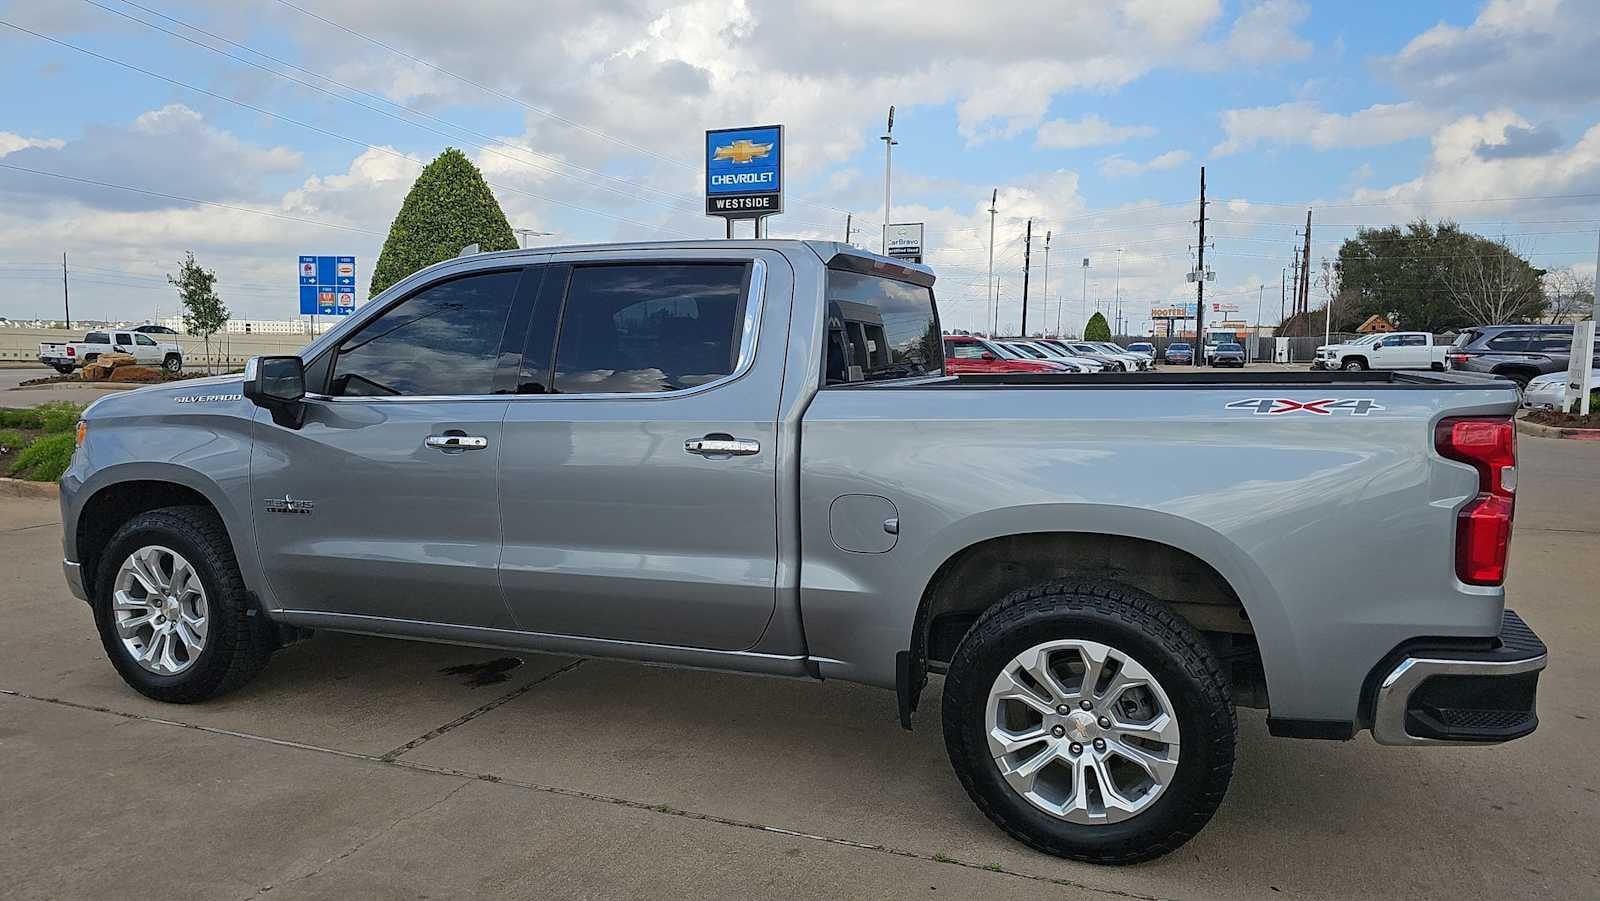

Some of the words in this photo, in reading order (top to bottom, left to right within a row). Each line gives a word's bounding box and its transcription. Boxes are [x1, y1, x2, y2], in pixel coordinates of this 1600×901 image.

[712, 172, 774, 185] CHEVROLET
[716, 197, 770, 209] WESTSIDE
[1152, 307, 1185, 316] HOOTERS
[174, 394, 242, 403] SILVERADO
